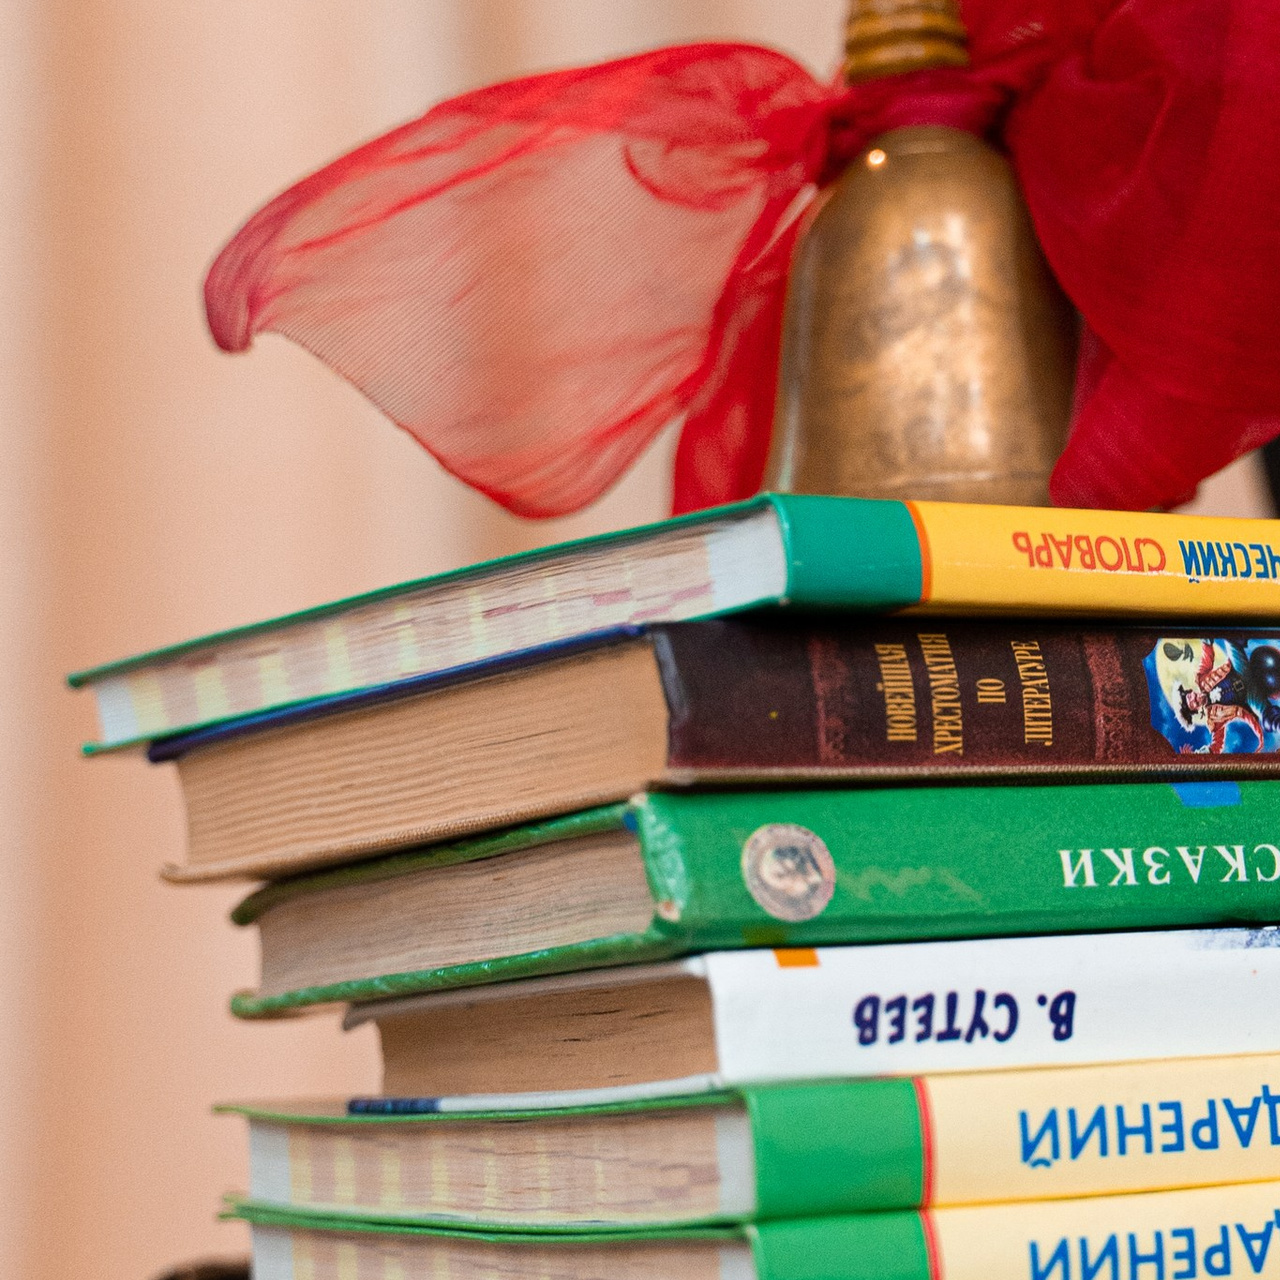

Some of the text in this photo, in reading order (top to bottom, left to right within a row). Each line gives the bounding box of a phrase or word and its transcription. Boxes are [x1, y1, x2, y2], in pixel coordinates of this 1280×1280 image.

[1012, 532, 1166, 575] СЛОВАРЬ
[876, 644, 919, 742] НОВЕЙШАЯ
[918, 633, 963, 755] ХРЕСТОМАТИЯ
[976, 678, 1006, 704] ПО
[1011, 641, 1053, 746] ЛИТЕРАТУРЕ
[852, 990, 1076, 1046] В. СУТЕЕВ
